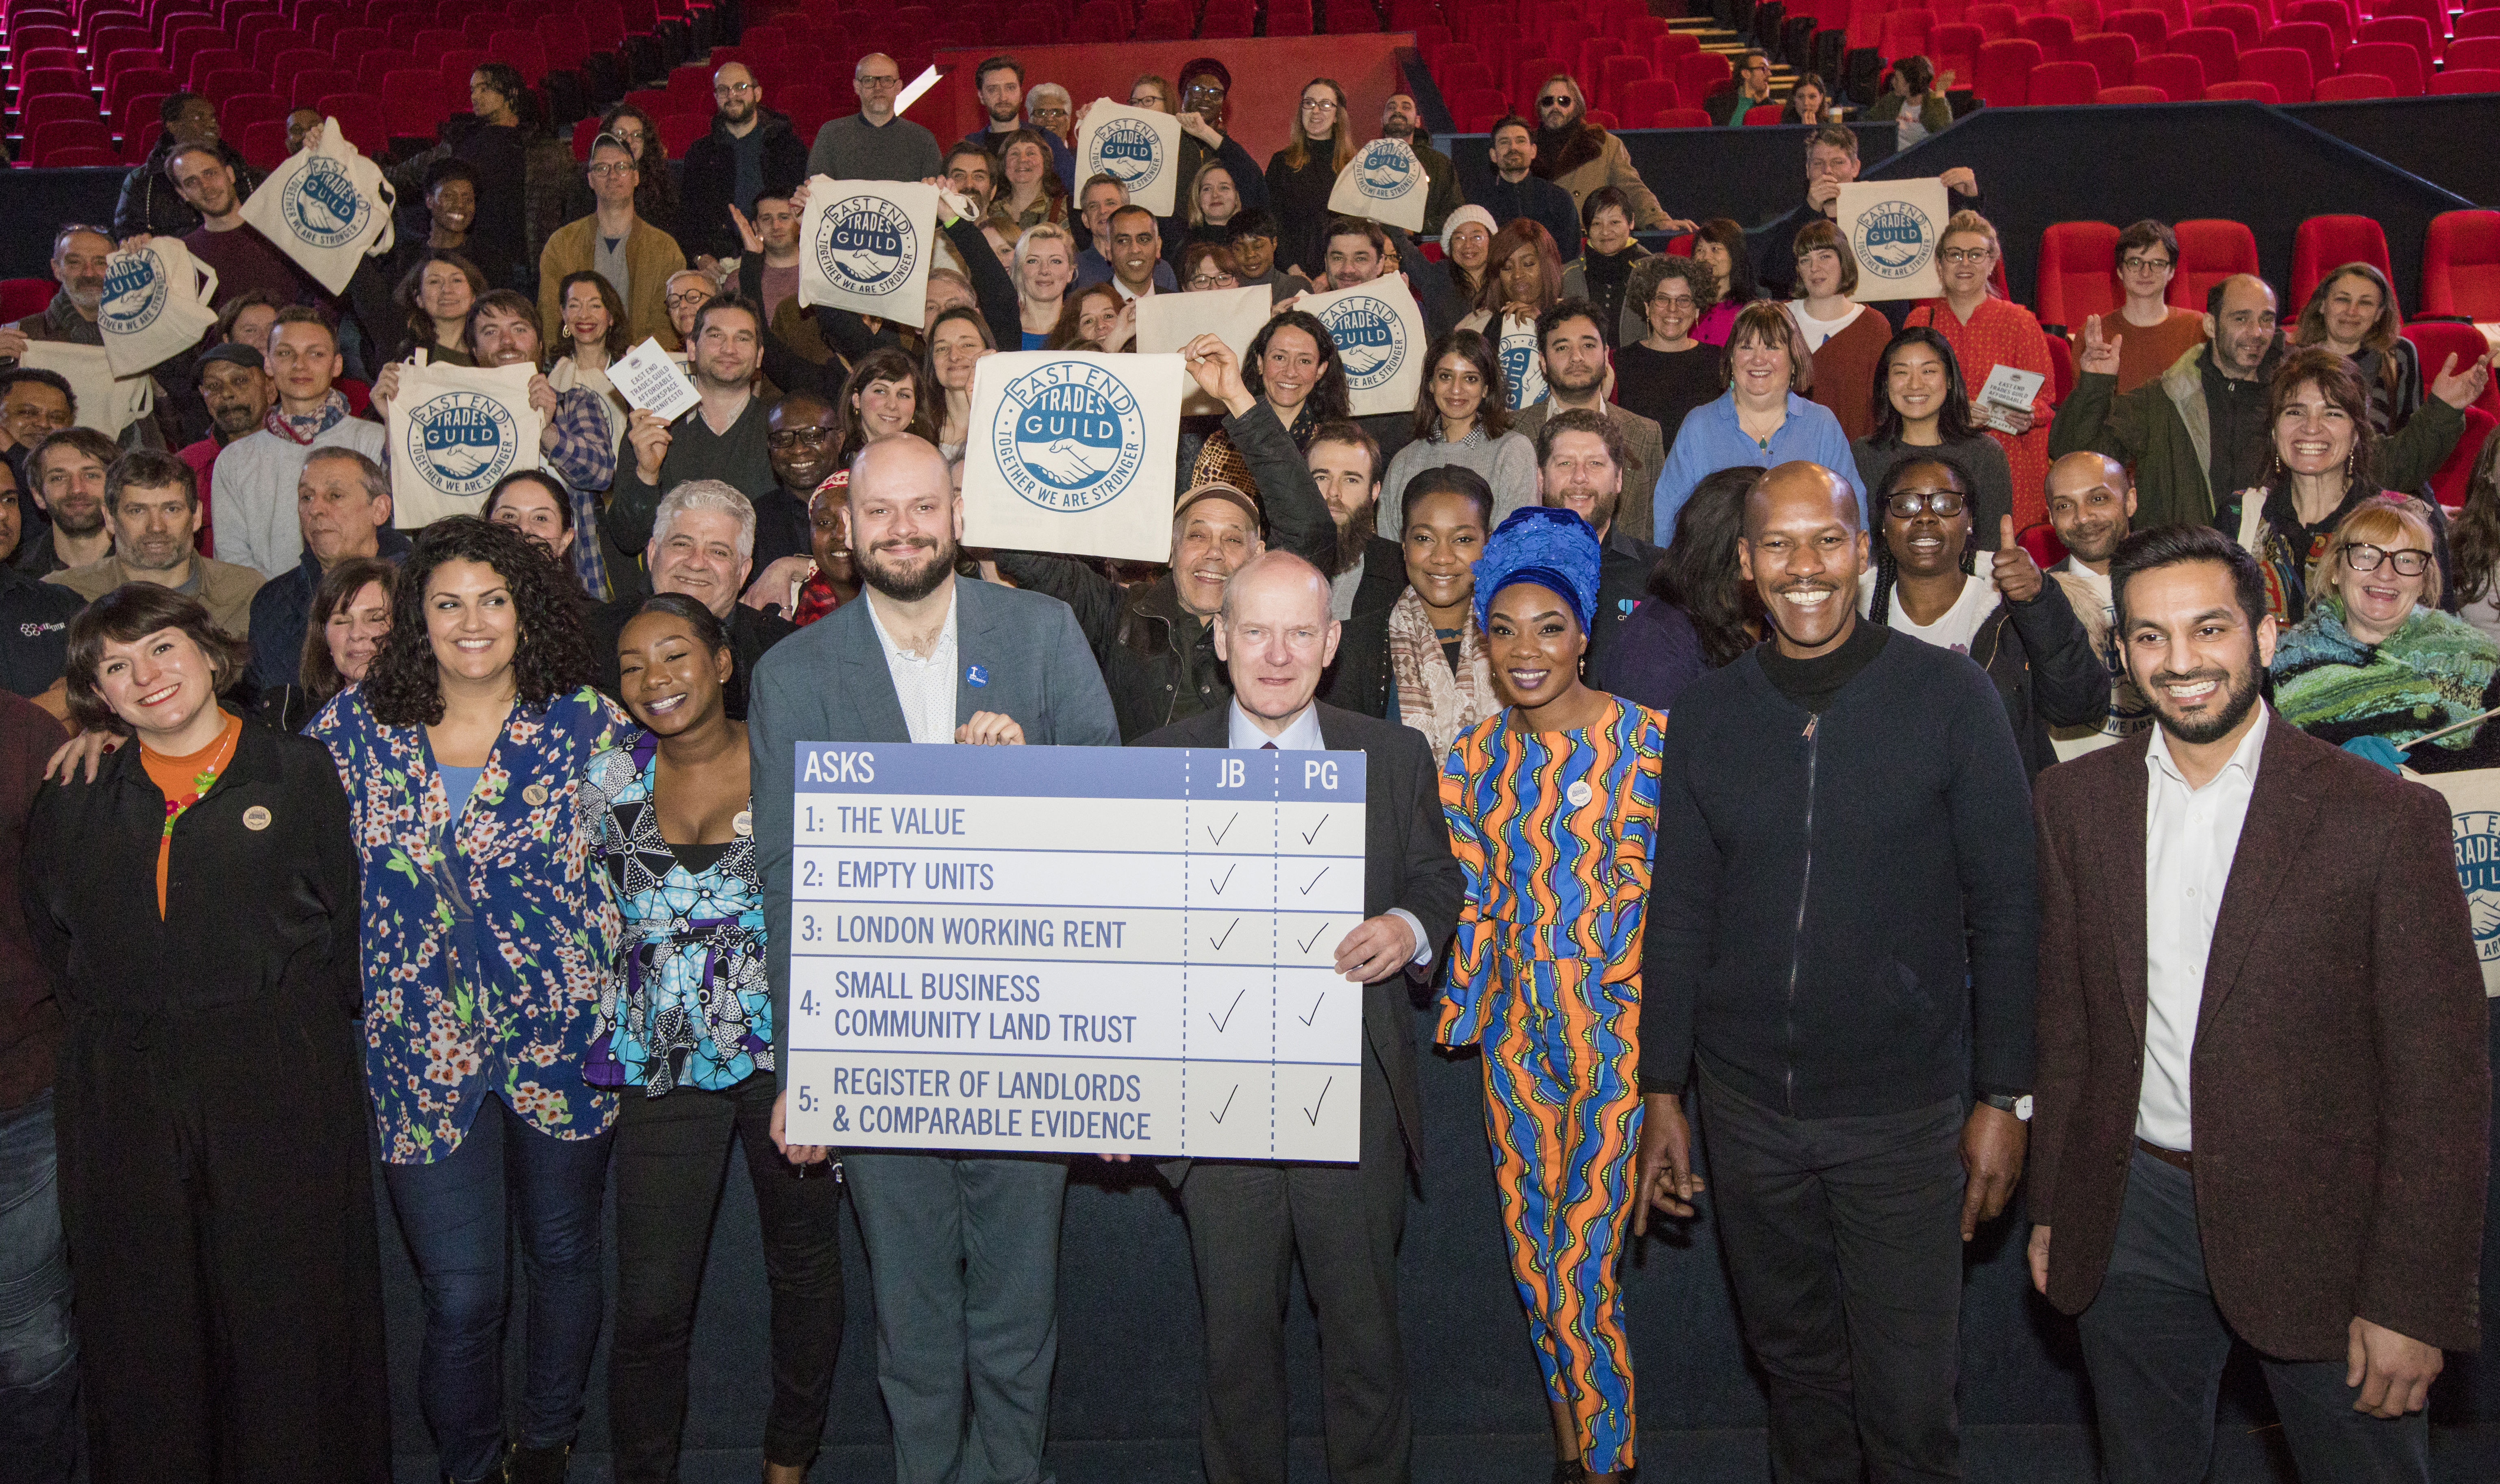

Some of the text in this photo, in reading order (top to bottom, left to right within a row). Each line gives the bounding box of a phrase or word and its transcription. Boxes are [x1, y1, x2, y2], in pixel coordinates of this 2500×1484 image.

[1094, 120, 1159, 144] EAST END
[1112, 130, 1144, 145] TRADES
[1105, 145, 1148, 157] GUILD
[1092, 153, 1103, 174] TOGET
[1137, 158, 1160, 187] STRONGER
[306, 179, 350, 216] GUILD
[824, 198, 911, 235] EAST END
[848, 213, 892, 234] TRADES
[1857, 203, 1927, 230] EAST END
[1877, 213, 1913, 228] TRADES
[837, 231, 896, 250] GUILD
[1870, 229, 1918, 241] GUILD
[106, 260, 143, 280] RADES
[819, 240, 842, 282] TOGETHER
[842, 278, 856, 290] WE
[879, 253, 913, 292] STRONGER
[1882, 267, 1892, 276] WE
[1895, 267, 1909, 276] ARE
[1318, 299, 1397, 331] EAST END
[1338, 312, 1379, 330] TRADES
[1332, 329, 1386, 345] GUILD
[631, 371, 647, 386] EAST
[646, 363, 658, 376] END
[1347, 339, 1403, 387] WE ARE STRONGER
[630, 379, 654, 397] TRADES
[652, 365, 670, 382] GUILD
[638, 373, 674, 403] AFFORDABLE
[1004, 365, 1136, 415] EAST END
[1506, 352, 1525, 404] GUILD
[643, 381, 679, 408] WORKSPACE
[653, 389, 684, 415] MANIFESTO
[1040, 386, 1105, 415] TRADES
[409, 394, 509, 427] EAST END
[436, 408, 487, 426] TRADES
[427, 428, 493, 444] GUILD
[1025, 415, 1114, 439] GUILD
[412, 441, 513, 492] TOGETHER WE ARE STRONGER
[999, 431, 1139, 507] TOGETHER WE ARE STRONGER
[2107, 718, 2127, 733] WE
[803, 751, 1338, 790] ASKS JB PG
[805, 806, 966, 835] 1: THE VALUE
[2455, 837, 2500, 866] RADE
[803, 860, 994, 891] 2: EMPTY UNITS
[2459, 867, 2500, 889] UIL
[802, 915, 1127, 948] 3: LONDON WORKING RENT
[2484, 939, 2500, 957] AR
[835, 971, 1040, 1002] SMALL BUSINESS
[799, 990, 821, 1016] 4:
[834, 1009, 1137, 1043] COMMUNITY LAND TRUST
[799, 1085, 819, 1112] 5:
[834, 1067, 1141, 1102] REGISTER OF LANDLORDS
[833, 1104, 1151, 1141] & COMPARABLE EVIDENCE
